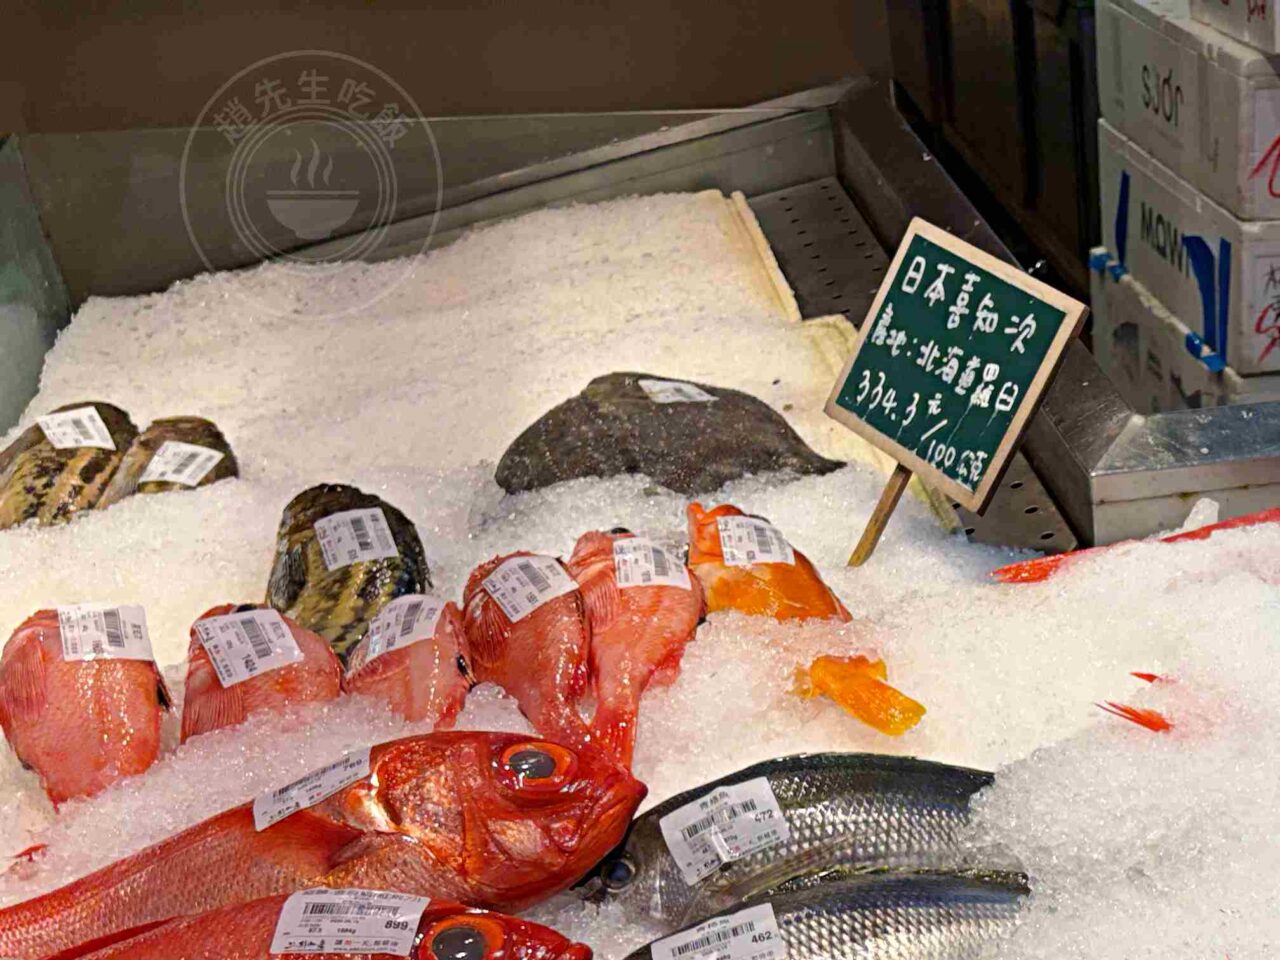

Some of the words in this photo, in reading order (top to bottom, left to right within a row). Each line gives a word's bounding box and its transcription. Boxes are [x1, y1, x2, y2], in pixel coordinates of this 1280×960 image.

[902, 255, 1037, 353] 日本喜知次
[754, 808, 774, 823] 472
[384, 919, 409, 931] 899
[751, 930, 772, 944] 462
